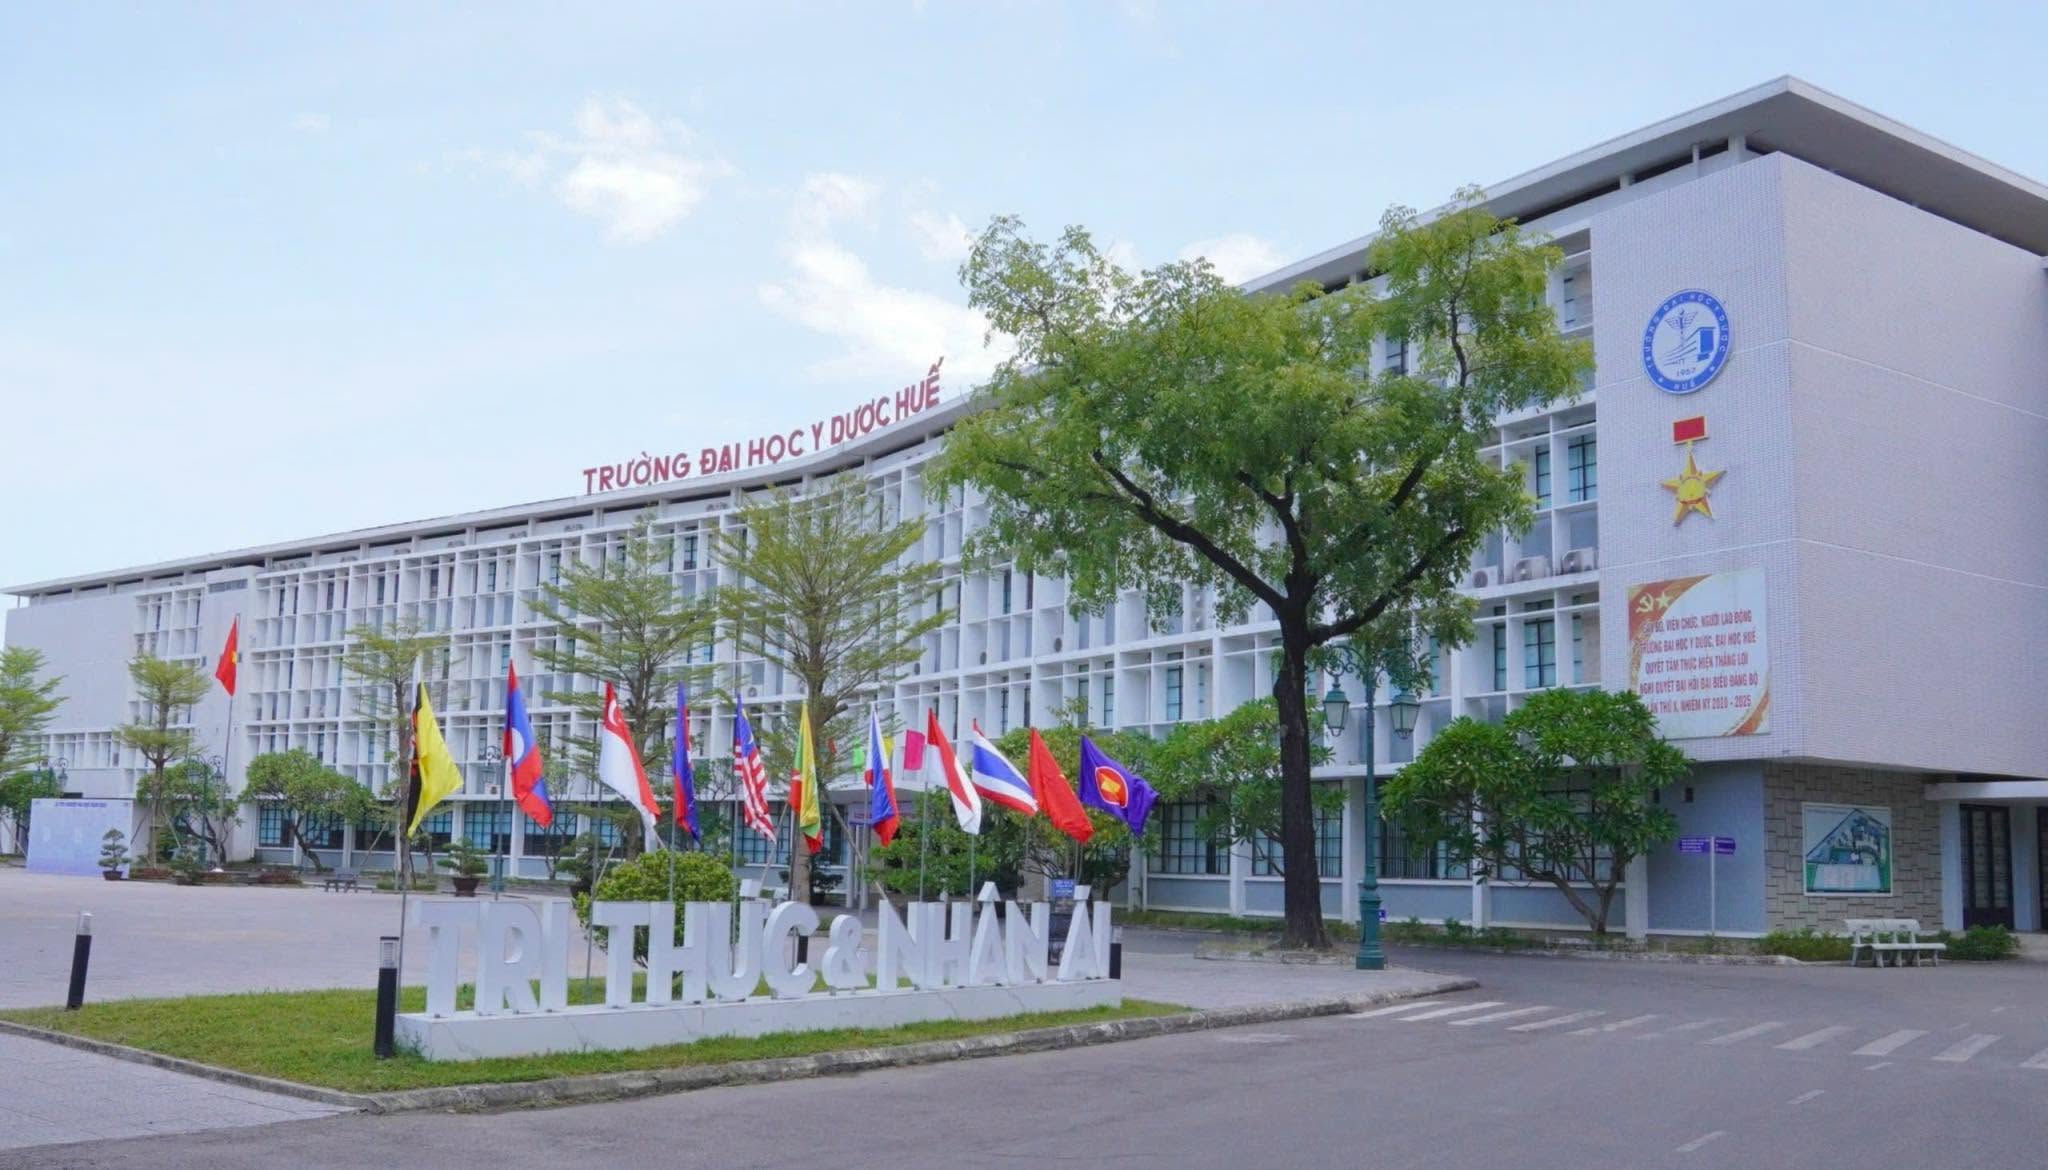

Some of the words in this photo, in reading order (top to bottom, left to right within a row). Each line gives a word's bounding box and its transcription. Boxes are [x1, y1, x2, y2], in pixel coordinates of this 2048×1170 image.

[583, 451, 690, 496] TRƯỜNG
[699, 442, 741, 475] ĐẠI
[748, 430, 804, 466] HỌC
[811, 422, 824, 450] Y
[831, 397, 890, 446] DƯỢC
[895, 356, 944, 421] HUẾ
[1689, 636, 1694, 649] Y
[1734, 694, 1752, 708] 2025
[411, 900, 570, 1018] TRI
[591, 877, 822, 1001] THỨC
[822, 914, 868, 989] &
[876, 880, 1049, 992] NHÂN
[1056, 884, 1111, 981] ÁI
